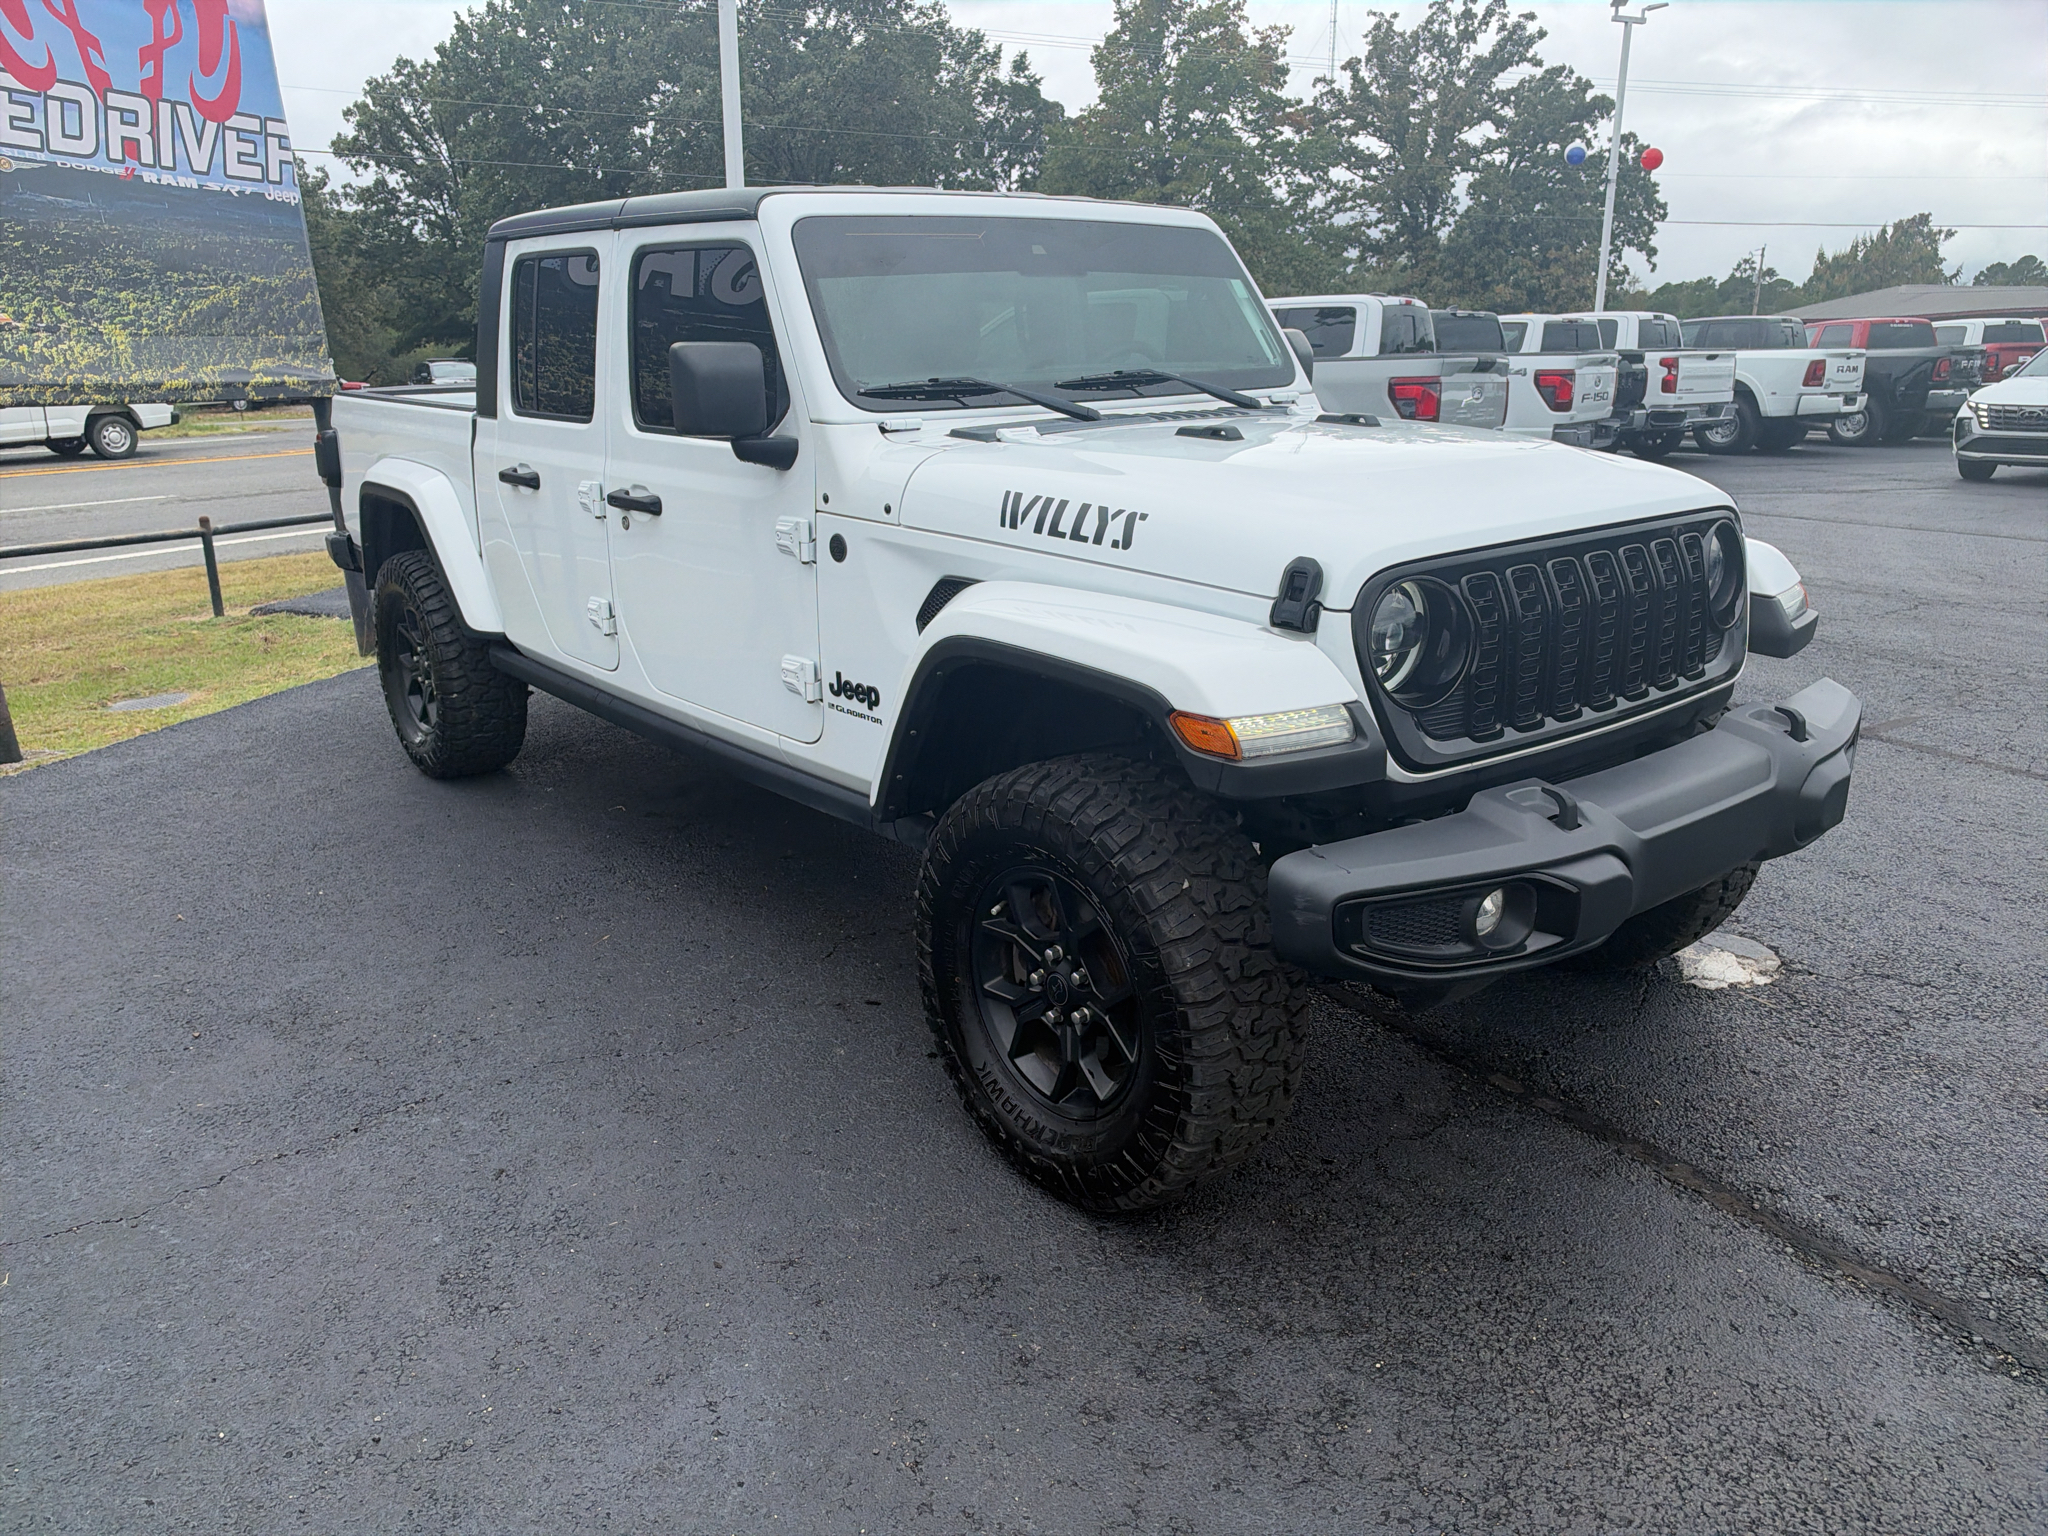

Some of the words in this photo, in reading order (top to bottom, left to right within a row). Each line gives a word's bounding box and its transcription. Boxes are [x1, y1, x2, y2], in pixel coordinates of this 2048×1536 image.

[56, 160, 130, 176] DODGE
[143, 172, 199, 190] RAM
[202, 181, 258, 198] SRT
[264, 185, 300, 207] Jeep
[1836, 365, 1859, 374] RAM
[1580, 391, 1609, 404] F-150
[828, 670, 881, 712] Jeep
[835, 704, 884, 726] GLADIATOR
